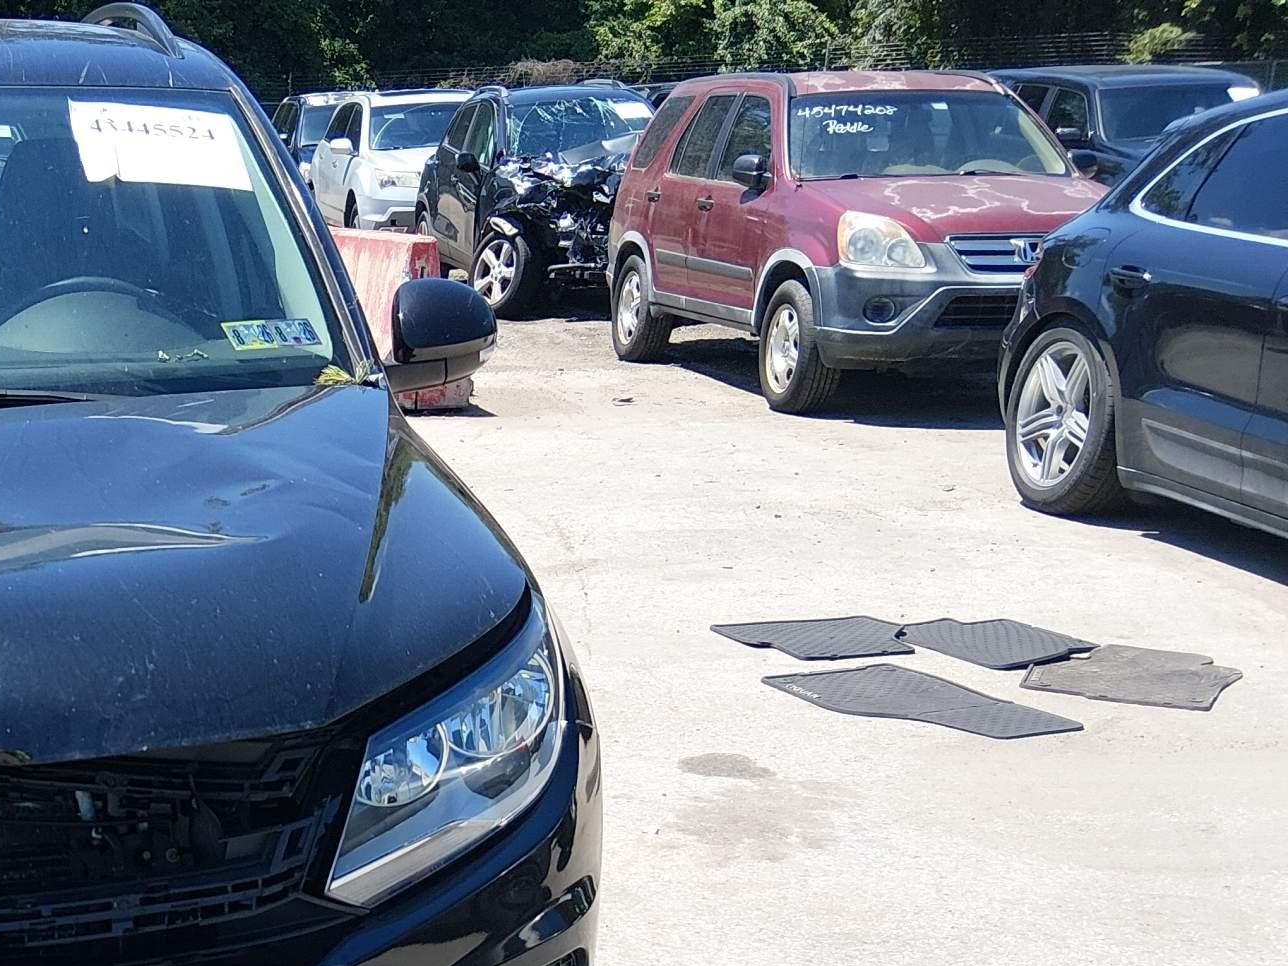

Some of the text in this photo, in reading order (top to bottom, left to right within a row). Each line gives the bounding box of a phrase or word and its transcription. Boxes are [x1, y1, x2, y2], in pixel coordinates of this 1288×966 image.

[796, 104, 898, 118] 45474208
[232, 329, 246, 345] 8
[274, 326, 288, 342] 8
